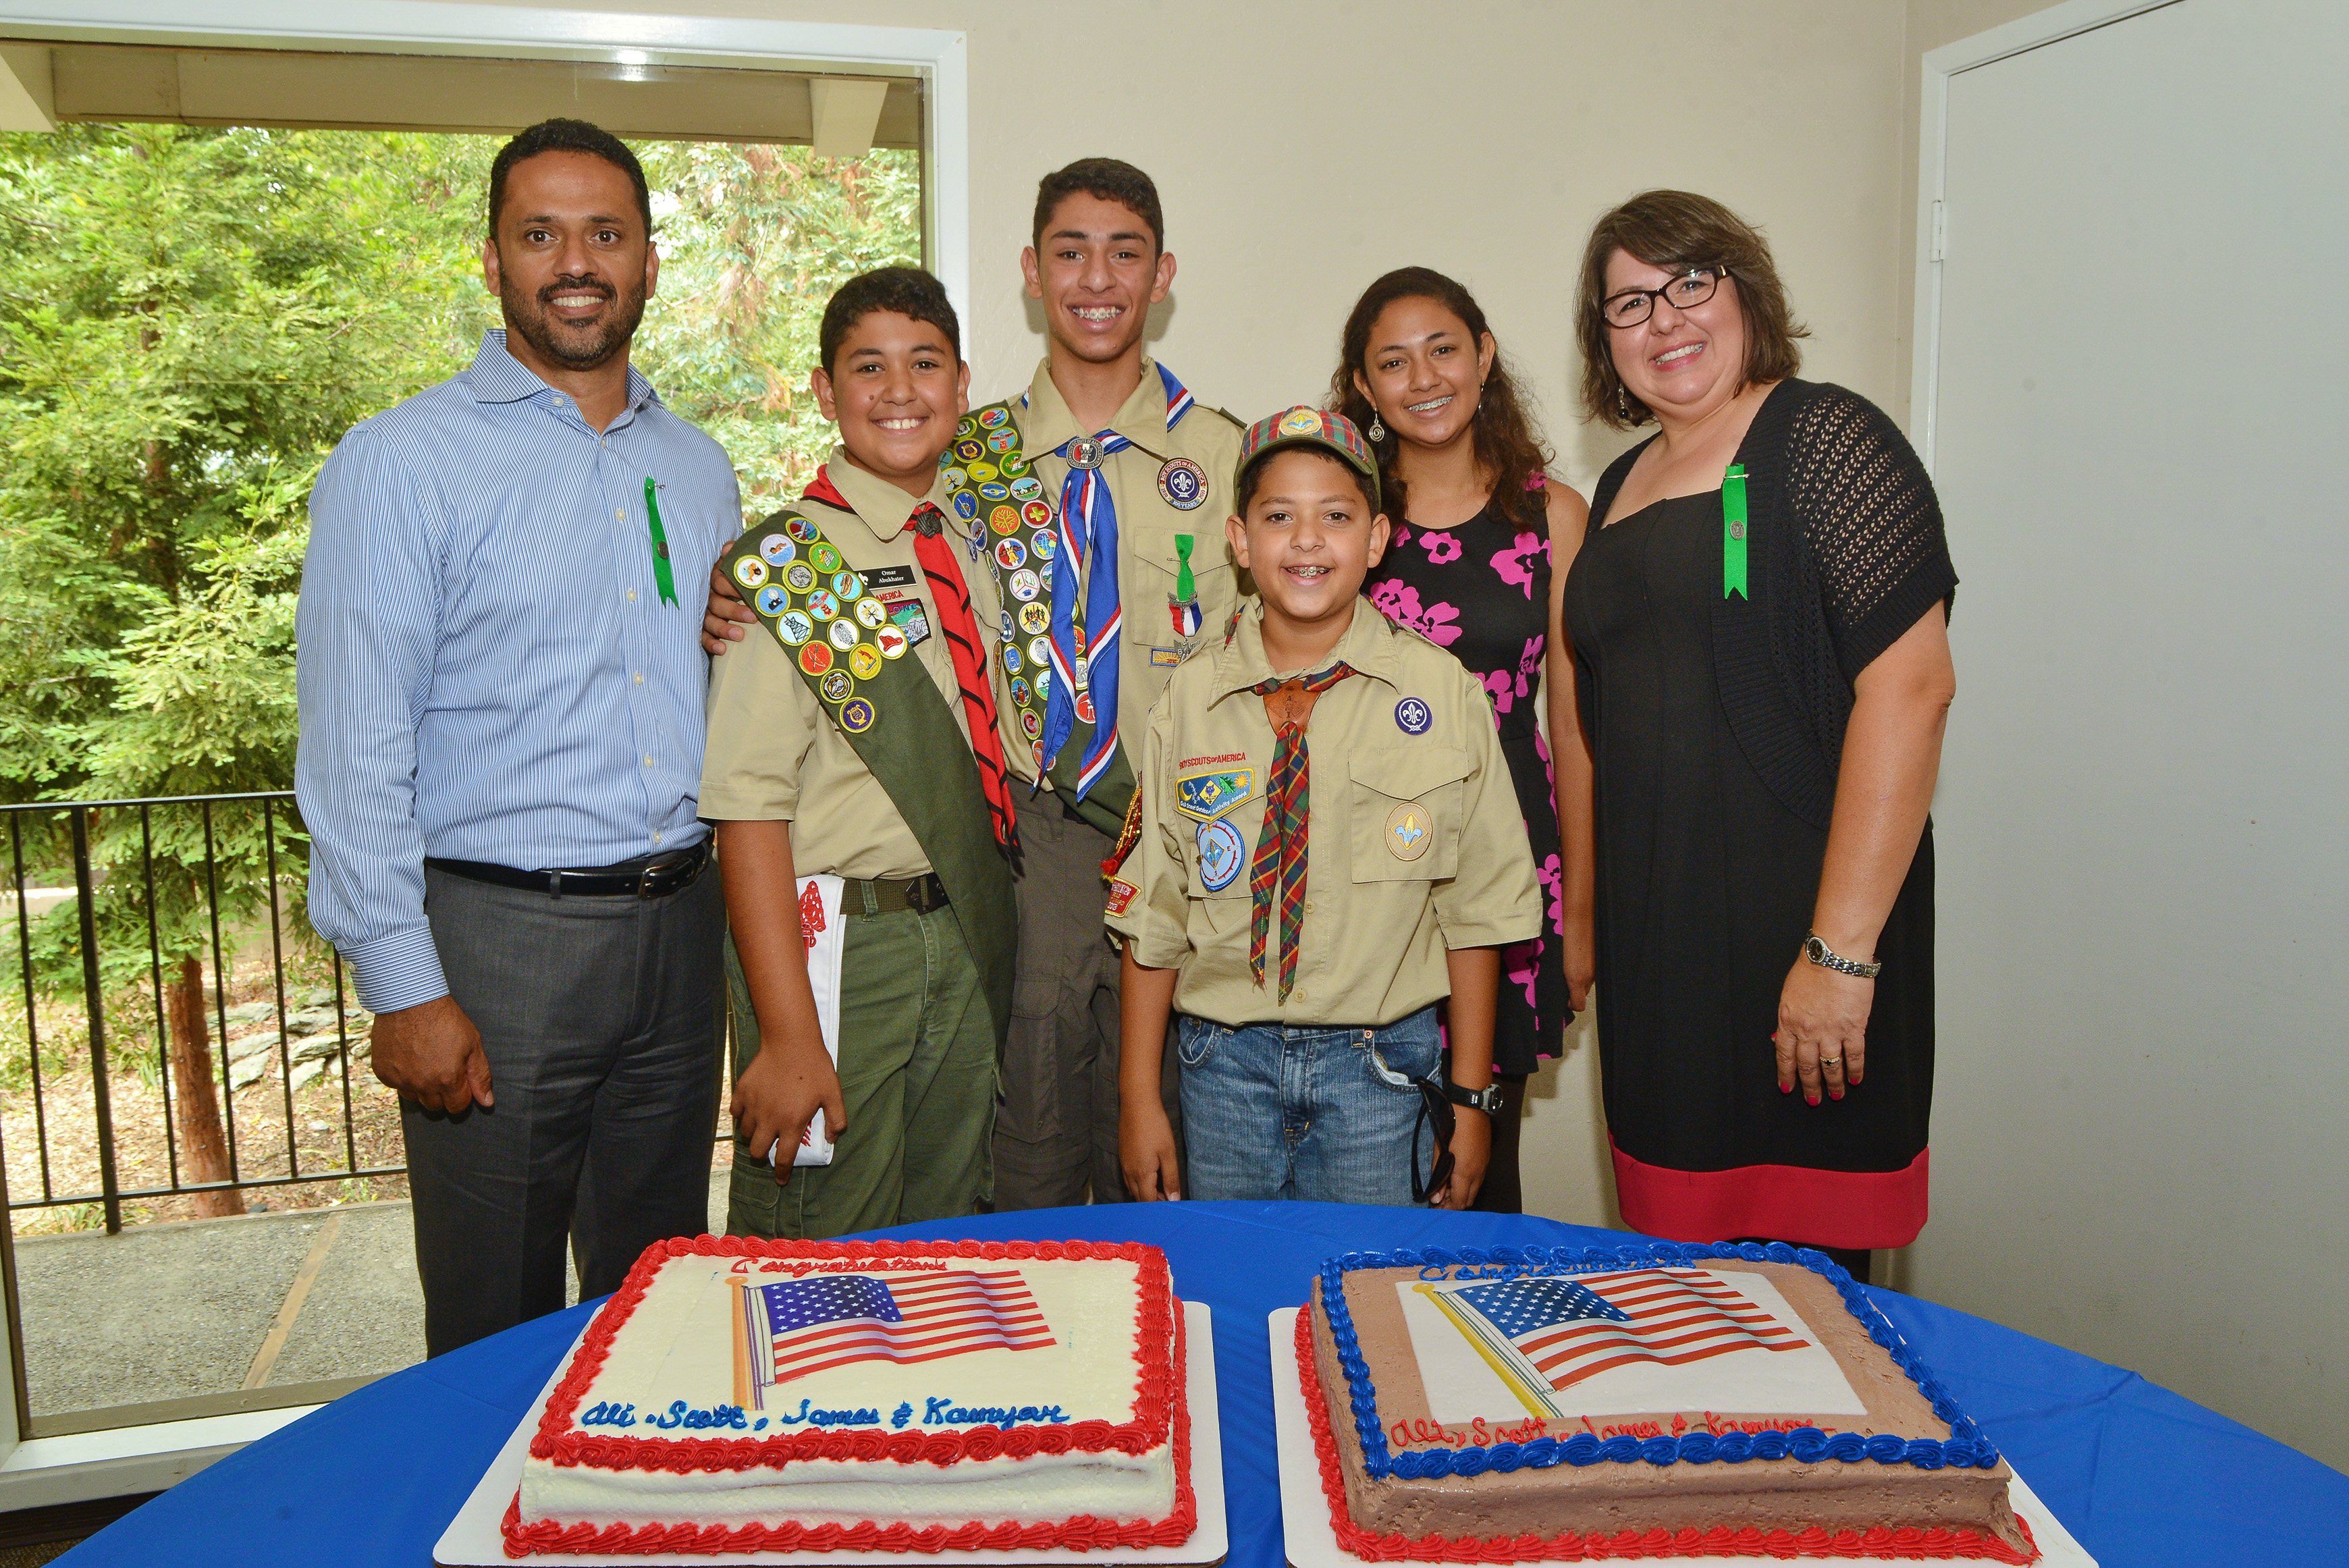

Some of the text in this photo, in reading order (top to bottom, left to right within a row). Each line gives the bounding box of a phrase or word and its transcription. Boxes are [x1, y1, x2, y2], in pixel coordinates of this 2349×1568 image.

[1165, 461, 1182, 472] SCOUTS
[1187, 463, 1205, 484] AMERICA
[1181, 500, 1197, 508] YEARS
[875, 589, 904, 602] AMERICA
[1179, 759, 1188, 769] BOY
[1187, 757, 1211, 767] SCOUTS
[1217, 752, 1246, 763] AMERICA
[1195, 806, 1211, 814] Outdoor
[1212, 801, 1230, 814] Activity
[1231, 792, 1247, 803] Award
[891, 1399, 913, 1429] &
